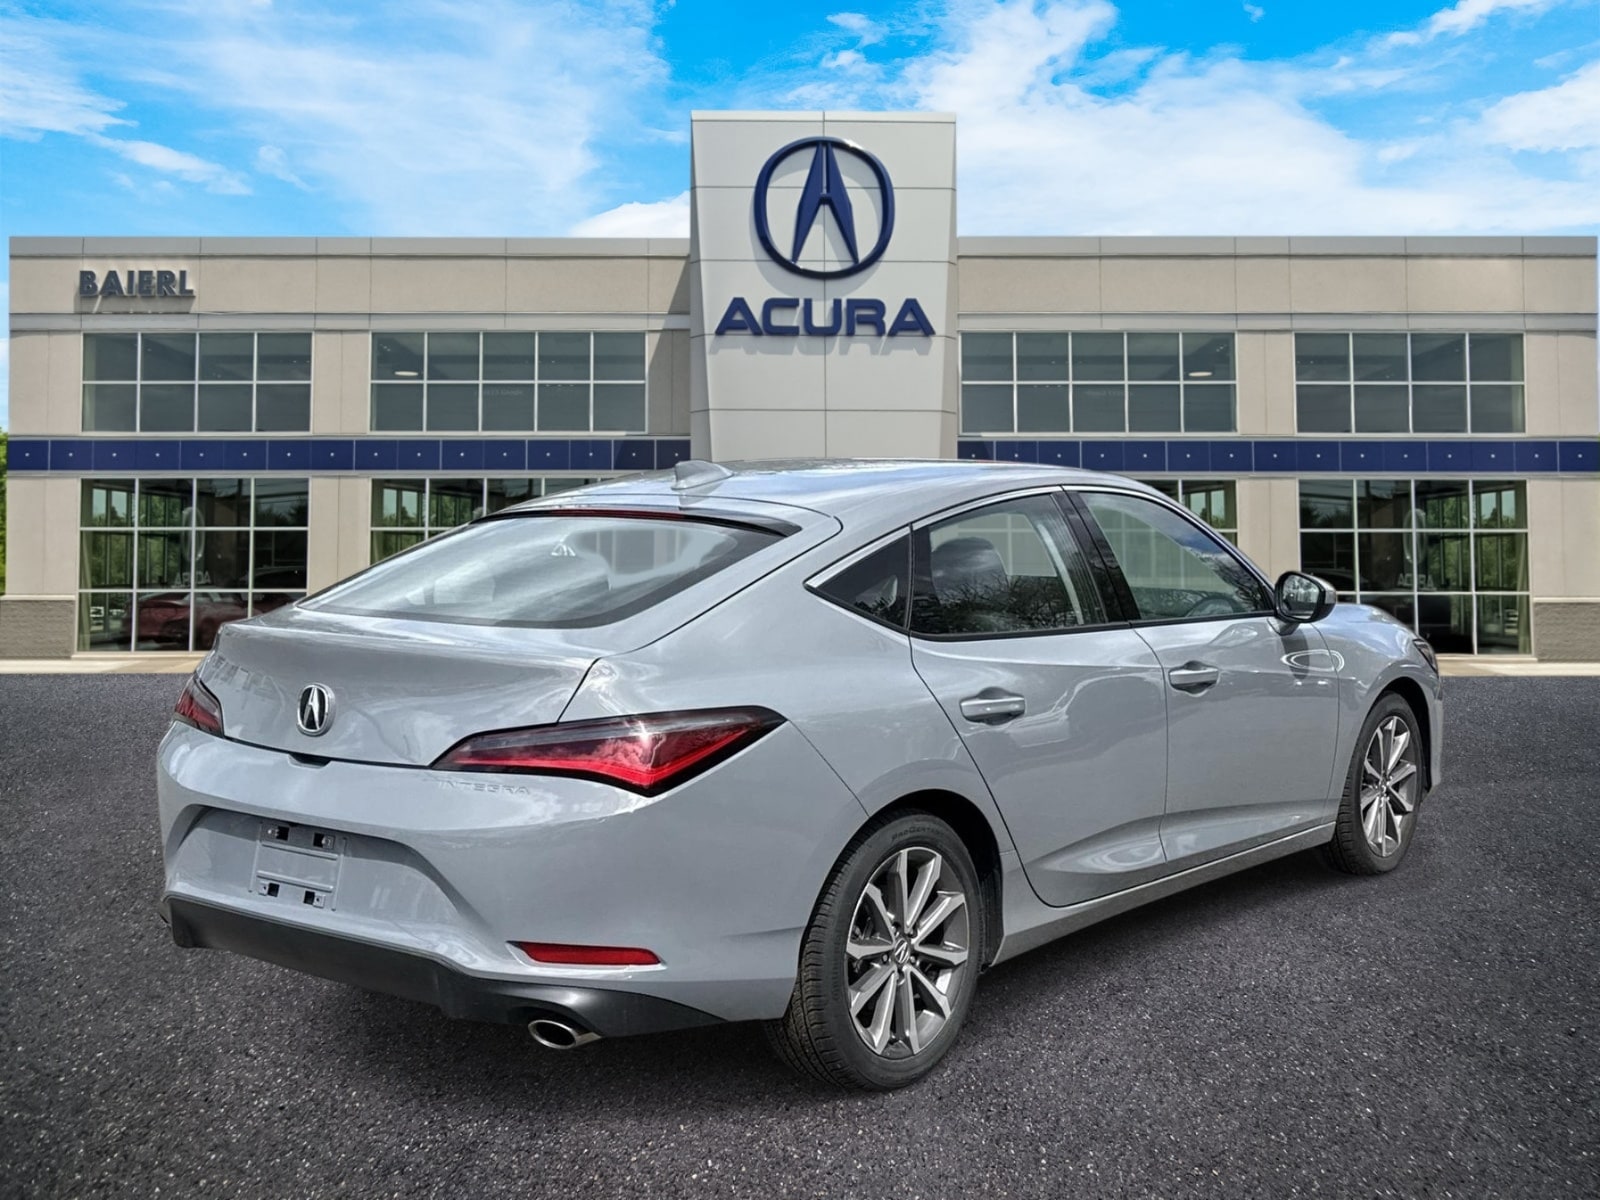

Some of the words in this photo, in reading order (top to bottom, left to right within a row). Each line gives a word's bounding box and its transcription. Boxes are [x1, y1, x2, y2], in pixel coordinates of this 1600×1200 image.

[79, 270, 194, 295] BAIERL
[715, 297, 936, 336] ACURA
[438, 779, 530, 795] INTEGRA
